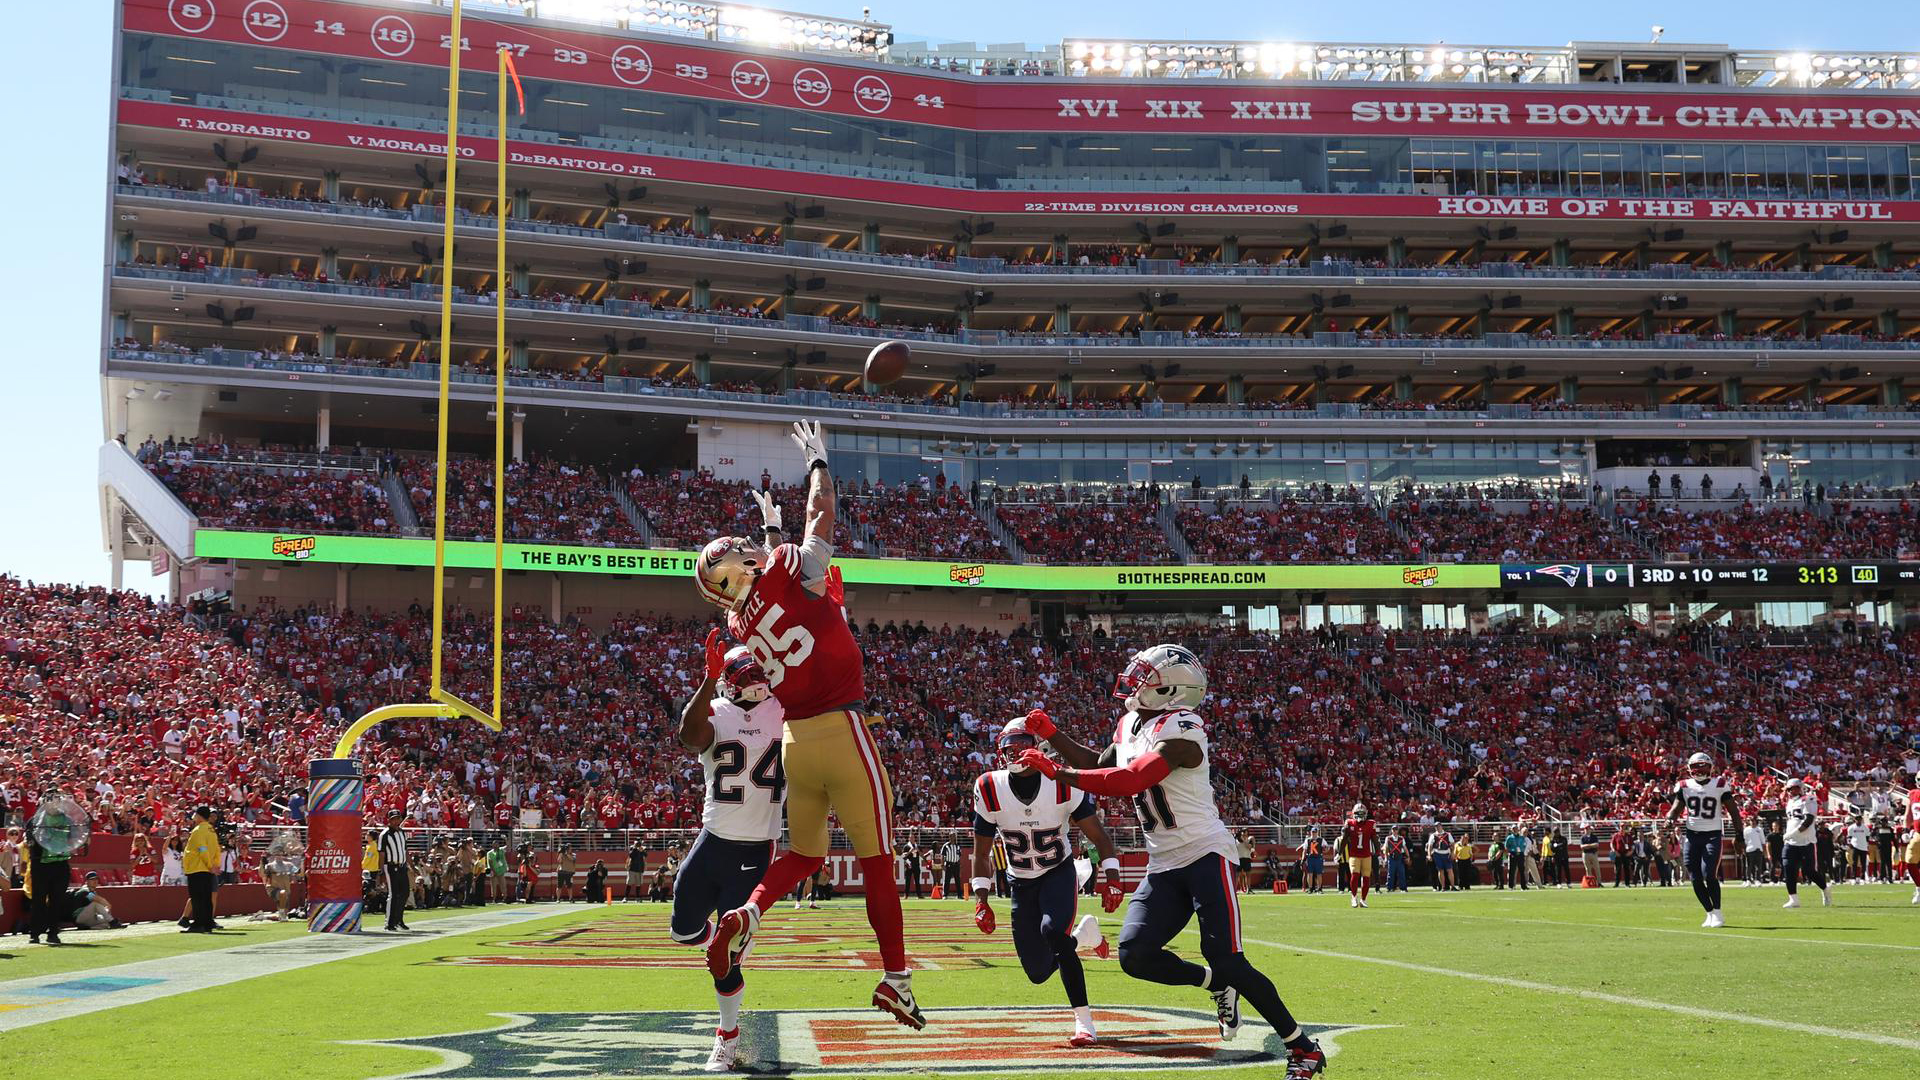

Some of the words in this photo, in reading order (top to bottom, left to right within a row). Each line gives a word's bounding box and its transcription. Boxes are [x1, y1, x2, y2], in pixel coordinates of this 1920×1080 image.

[182, 4, 202, 19] 8
[250, 12, 282, 28] 12
[314, 20, 346, 36] 14
[377, 28, 409, 43] 16
[555, 48, 588, 65] 33
[616, 56, 649, 72] 34
[675, 63, 708, 79] 35
[734, 70, 766, 86] 37
[796, 78, 828, 94] 39
[857, 86, 889, 101] 42
[913, 94, 945, 108] 44
[1057, 99, 1119, 118] XVI
[1145, 100, 1204, 119] XIX
[1230, 101, 1312, 120] XXIII
[1352, 101, 1511, 124] SUPER
[1525, 103, 1664, 126] BOWL
[1675, 106, 1920, 129] CHAMPION
[177, 118, 196, 131] T.
[196, 120, 311, 141] MORABITO
[347, 136, 364, 146] V.
[629, 165, 656, 177] JR.
[1024, 203, 1096, 213] 22-TIME
[1101, 203, 1188, 213] DIVISION
[1190, 204, 1299, 213] CHAMPIONS
[1438, 197, 1549, 216] HOME
[1560, 198, 1610, 217] OF
[1619, 199, 1695, 218] THE
[1709, 201, 1893, 220] FAITHFUL
[718, 457, 734, 466] 234
[272, 537, 315, 554] SPREAD
[521, 551, 552, 565] THE
[556, 553, 602, 567] BAY'S
[607, 555, 646, 568] BEST
[651, 557, 679, 570] BET
[683, 558, 698, 571] O
[950, 566, 984, 581] SPREAD
[1117, 573, 1266, 585] 810THESPREAD.COM
[1403, 567, 1438, 583] SPREAD
[1525, 571, 1531, 581] 1
[1605, 568, 1617, 582] 0
[1641, 568, 1675, 583] 3RD
[1679, 571, 1687, 580] &
[1692, 568, 1713, 582] 10
[1718, 571, 1731, 579] ON
[1732, 571, 1747, 579] THE
[1751, 568, 1768, 582] 12
[1798, 567, 1838, 583] 3:13
[1857, 568, 1873, 581] 40
[746, 602, 816, 689] 85
[713, 738, 787, 804] 24
[1687, 796, 1717, 819] 99
[251, 830, 265, 838] 130
[1357, 833, 1363, 848] 1
[1001, 825, 1066, 870] 25
[1310, 841, 1319, 854] K
[310, 856, 351, 869] CATCH
